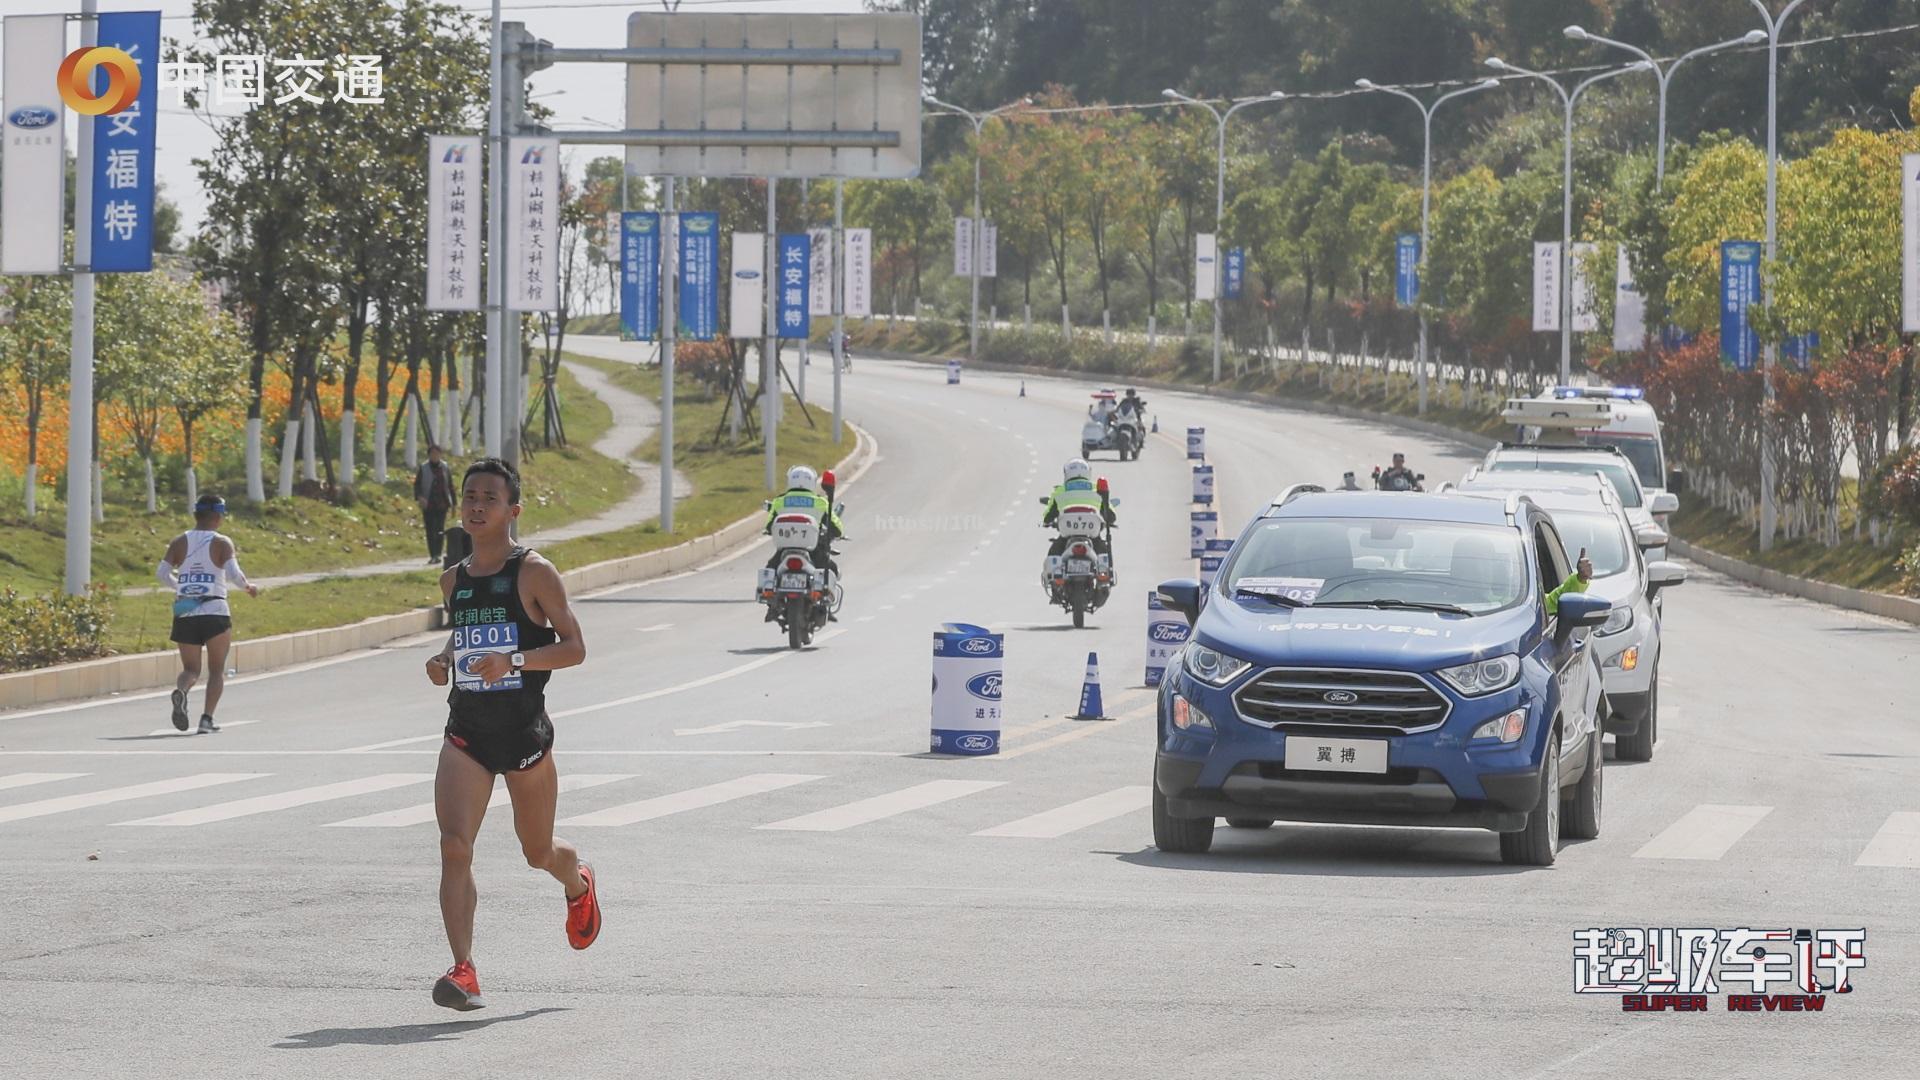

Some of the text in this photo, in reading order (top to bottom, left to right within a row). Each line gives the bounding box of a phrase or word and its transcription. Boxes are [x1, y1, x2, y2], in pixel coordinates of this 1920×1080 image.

[17, 109, 49, 126] Ford
[783, 245, 803, 328] 长安福特
[1287, 589, 1317, 601] 03
[454, 607, 507, 626] 华润怡宝
[1153, 624, 1188, 641] Ford
[965, 639, 990, 652] Ford
[1329, 692, 1350, 702] Ford
[963, 736, 988, 749] Ford
